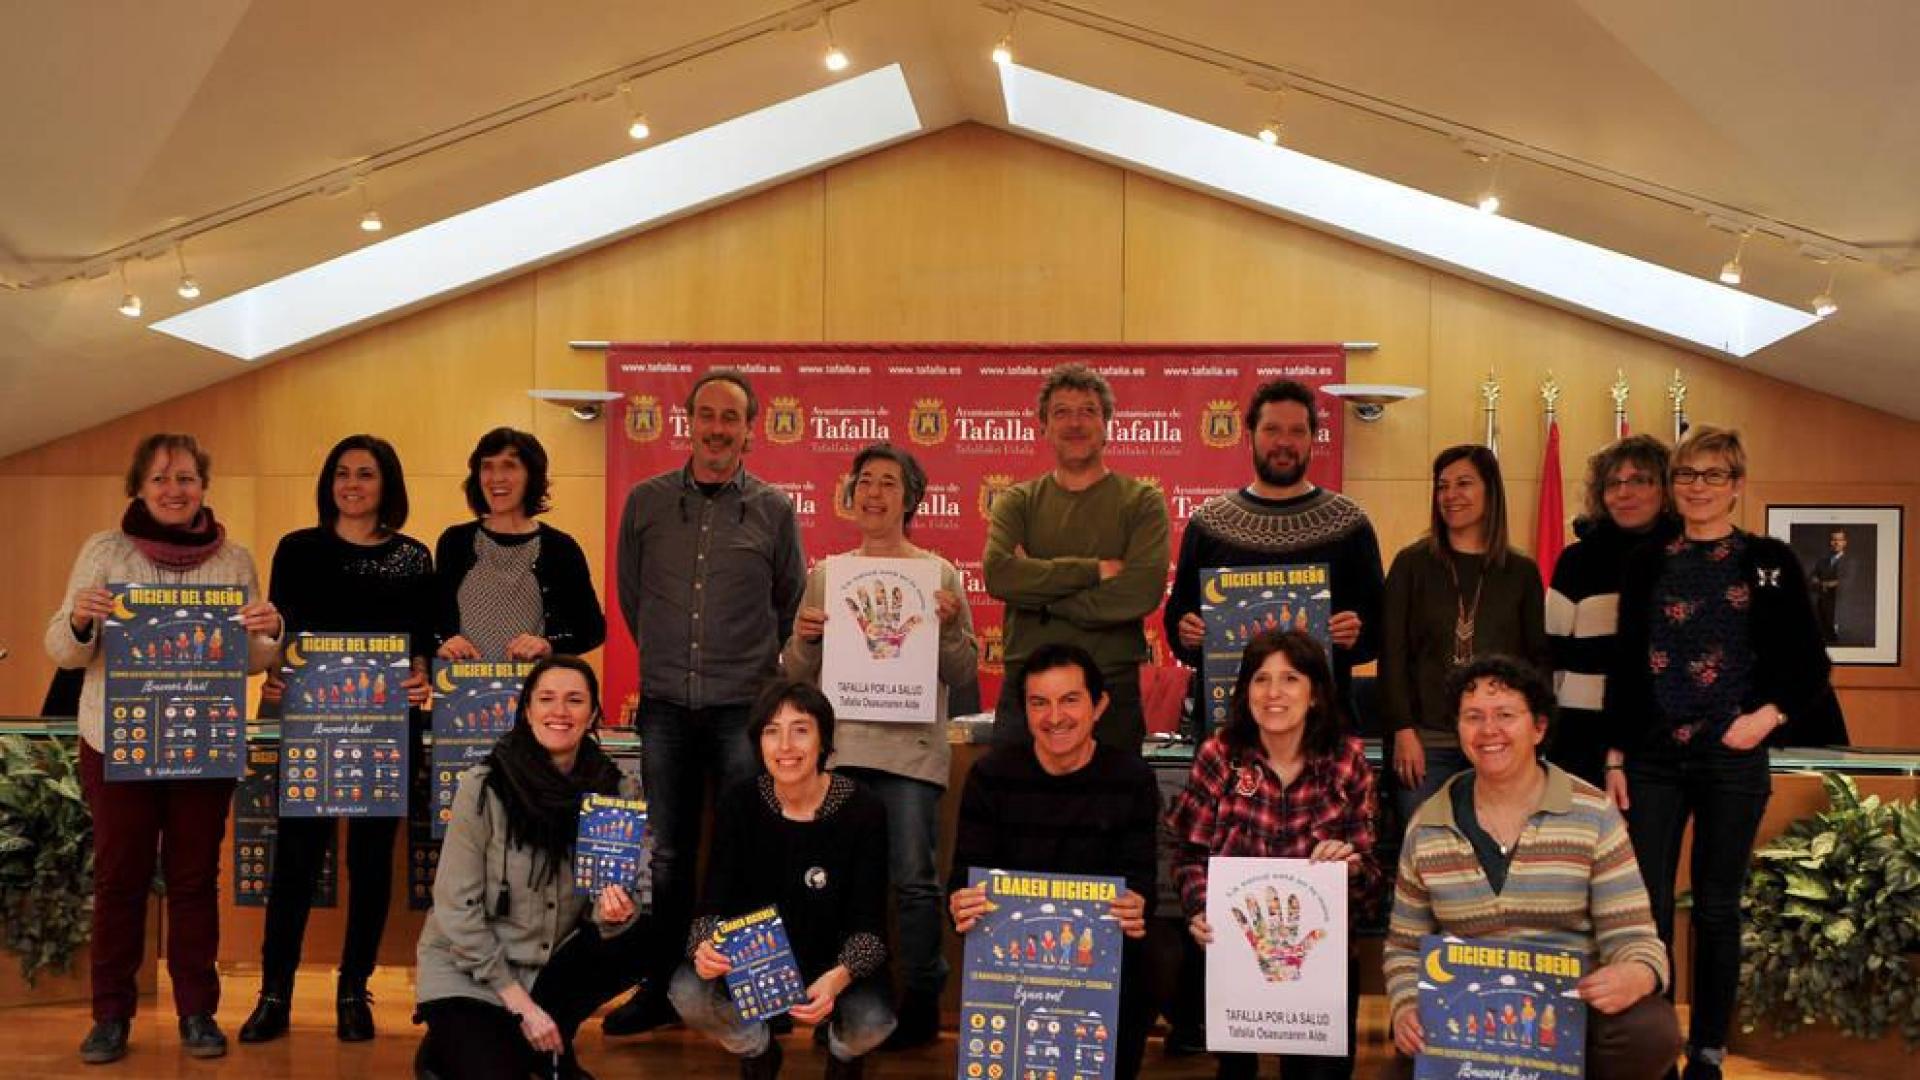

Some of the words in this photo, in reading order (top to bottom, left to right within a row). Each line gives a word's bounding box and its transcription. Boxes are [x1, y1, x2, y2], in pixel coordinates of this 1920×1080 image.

[620, 364, 693, 374] www.tafalla.es
[798, 365, 871, 375] www.tafalla.es
[888, 366, 962, 375] www.tafalla.es
[1163, 366, 1238, 377] www.tafalla.es
[1256, 366, 1333, 377] www.tafalla.es
[812, 405, 876, 417] Ayuntamiento
[878, 405, 889, 416] de
[954, 406, 1021, 418] Ayuntamiento
[1023, 406, 1036, 418] de
[1169, 408, 1182, 419] de
[810, 416, 890, 440] Tafalla
[954, 418, 1036, 441] Tafalla
[917, 494, 961, 516] alla
[1220, 572, 1266, 588] HIGIENE
[1266, 571, 1287, 586] DEL
[1287, 566, 1326, 586] SUEÑO
[130, 588, 179, 605] HIGIENE
[181, 589, 203, 605] DEL
[204, 587, 244, 606] SUEÑO
[302, 637, 345, 652] HIGIENE
[346, 638, 367, 652] DEL
[367, 635, 405, 652] SUEÑO
[452, 663, 494, 678] HIGIENE
[495, 663, 515, 678] DEL
[837, 682, 870, 692] TAFALLA
[870, 684, 885, 693] POR
[887, 684, 897, 694] LA
[898, 684, 922, 695] SALUD
[993, 875, 1048, 897] LOAREN
[1050, 879, 1117, 901] HIGIENEA
[1447, 944, 1506, 969] HIGIENE
[1508, 949, 1533, 971] DEL
[1534, 951, 1581, 978] SUEÑO
[1225, 1009, 1264, 1023] TAFALLA
[1264, 1011, 1285, 1024] POR
[1286, 1012, 1299, 1025] LA
[1300, 1012, 1330, 1026] SALUD
[1308, 1029, 1328, 1041] Alde
